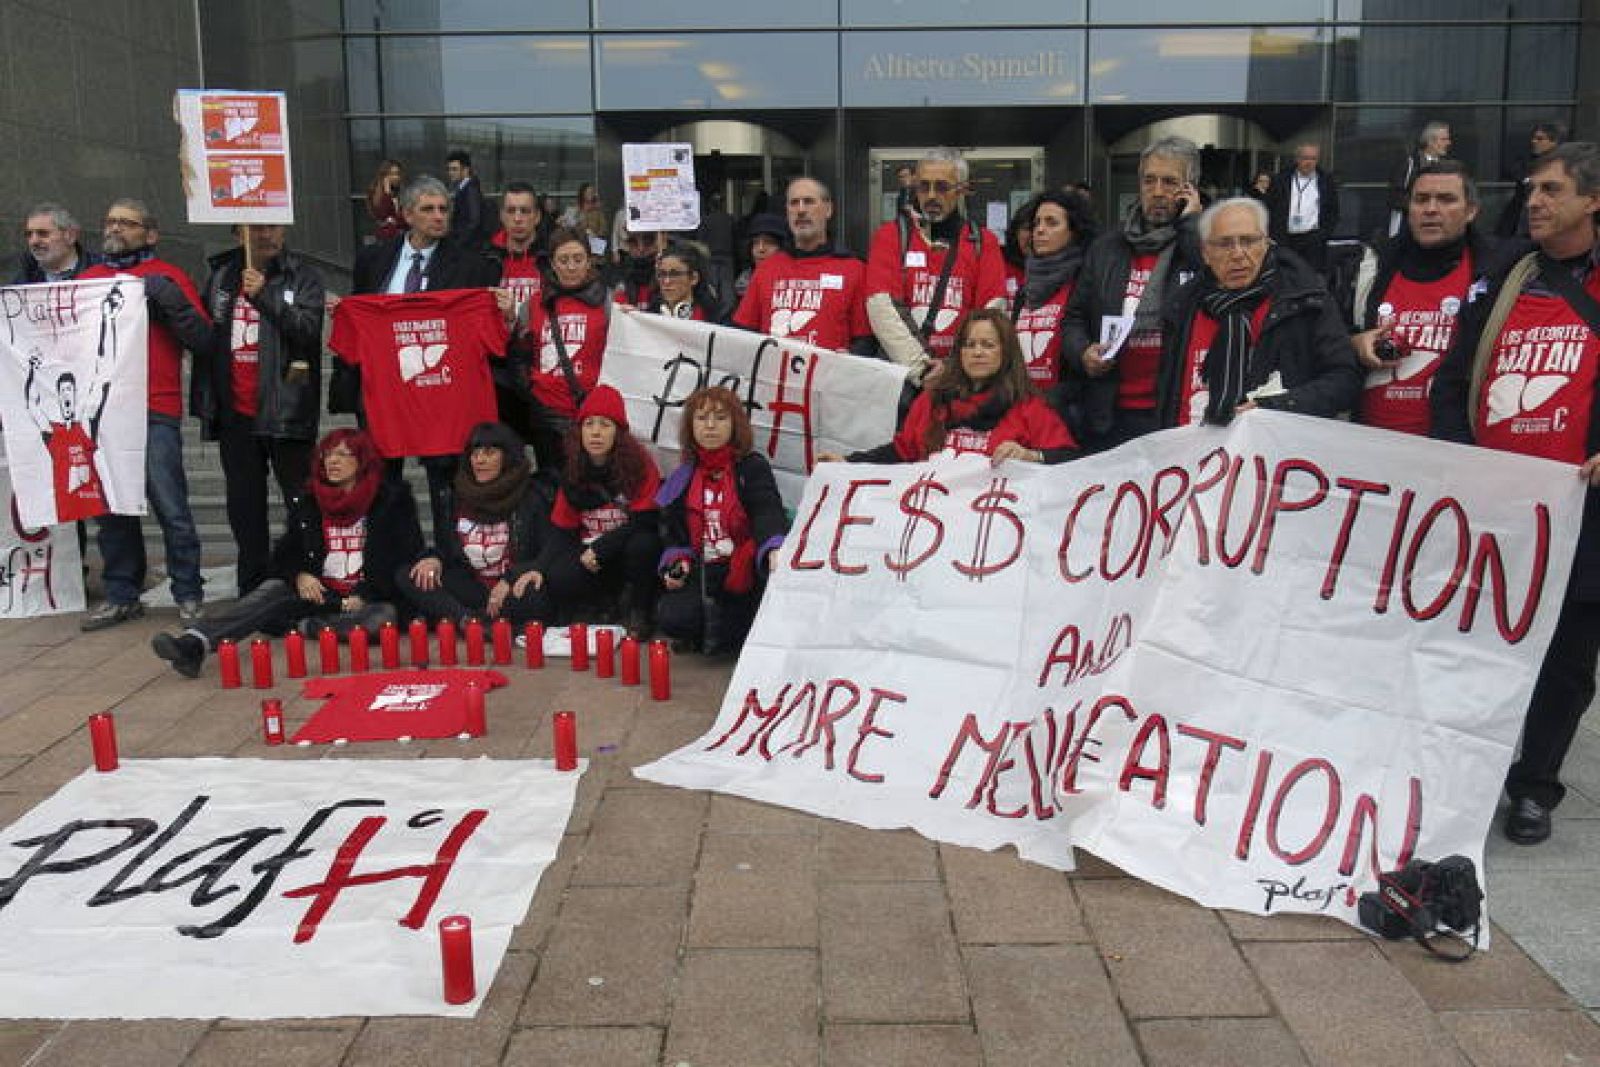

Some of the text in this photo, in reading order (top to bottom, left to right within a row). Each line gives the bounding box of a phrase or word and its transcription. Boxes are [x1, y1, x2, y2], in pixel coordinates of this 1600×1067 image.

[771, 288, 823, 311] MATAN
[1501, 325, 1590, 346] LOS RECORTES
[1496, 342, 1584, 374] MATAN
[1552, 406, 1569, 432] C
[790, 446, 1550, 644] LE$$ CORRUPTION
[1036, 613, 1132, 688] AND
[703, 678, 908, 783] MORE
